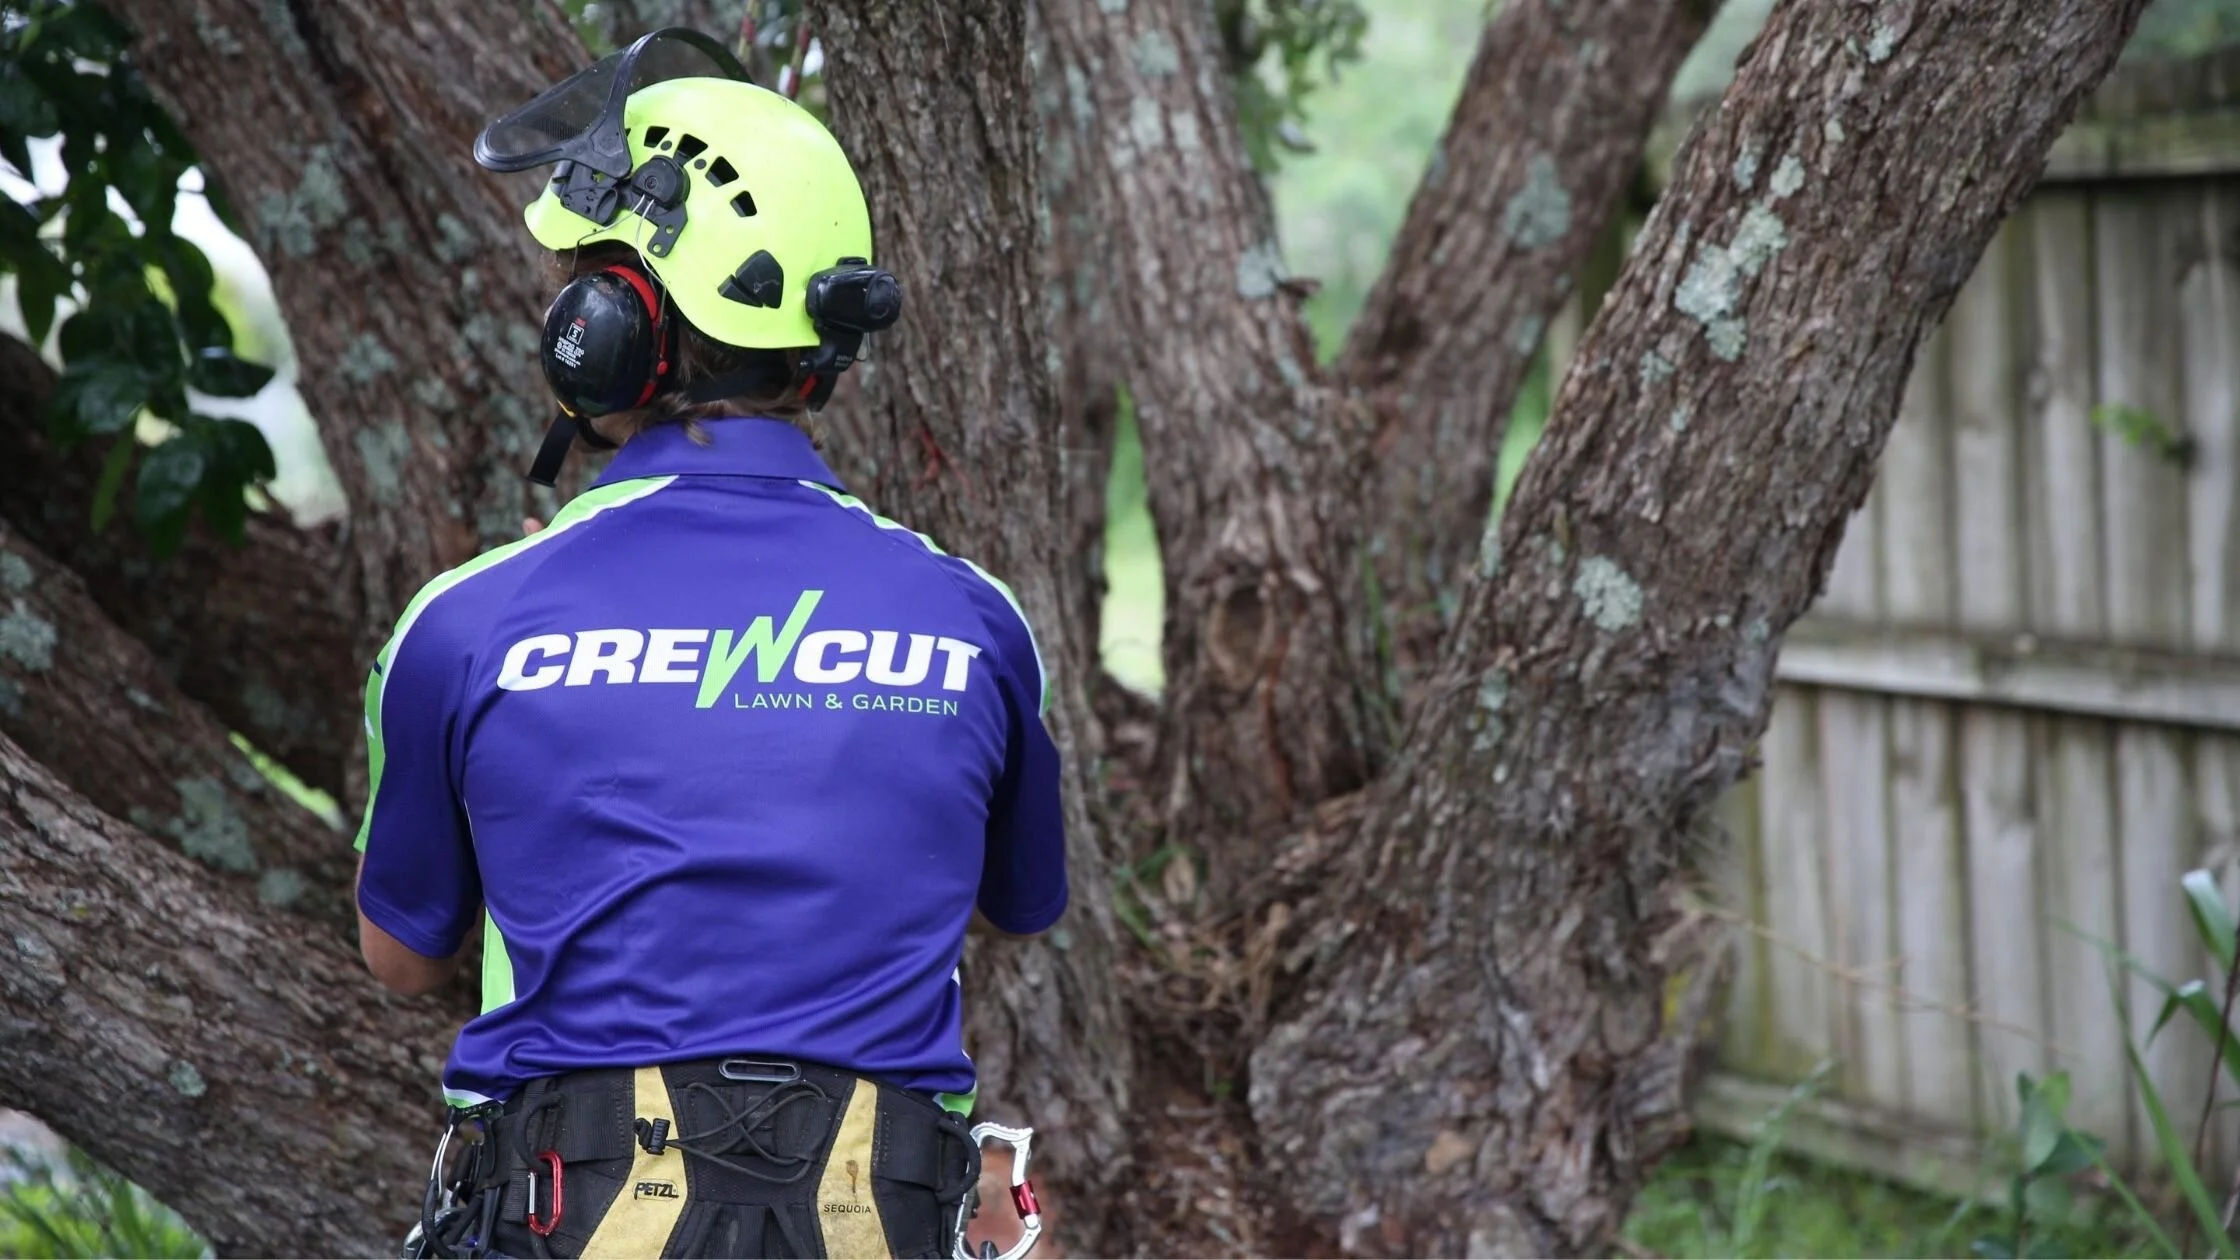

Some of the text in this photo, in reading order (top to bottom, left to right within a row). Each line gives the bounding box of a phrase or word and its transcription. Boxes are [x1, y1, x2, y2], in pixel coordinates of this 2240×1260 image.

[496, 589, 982, 708] CREWCUT
[734, 693, 958, 716] LAWN & GARDEN
[633, 1182, 680, 1201] PETZL
[823, 1203, 872, 1214] SEQUOIA
